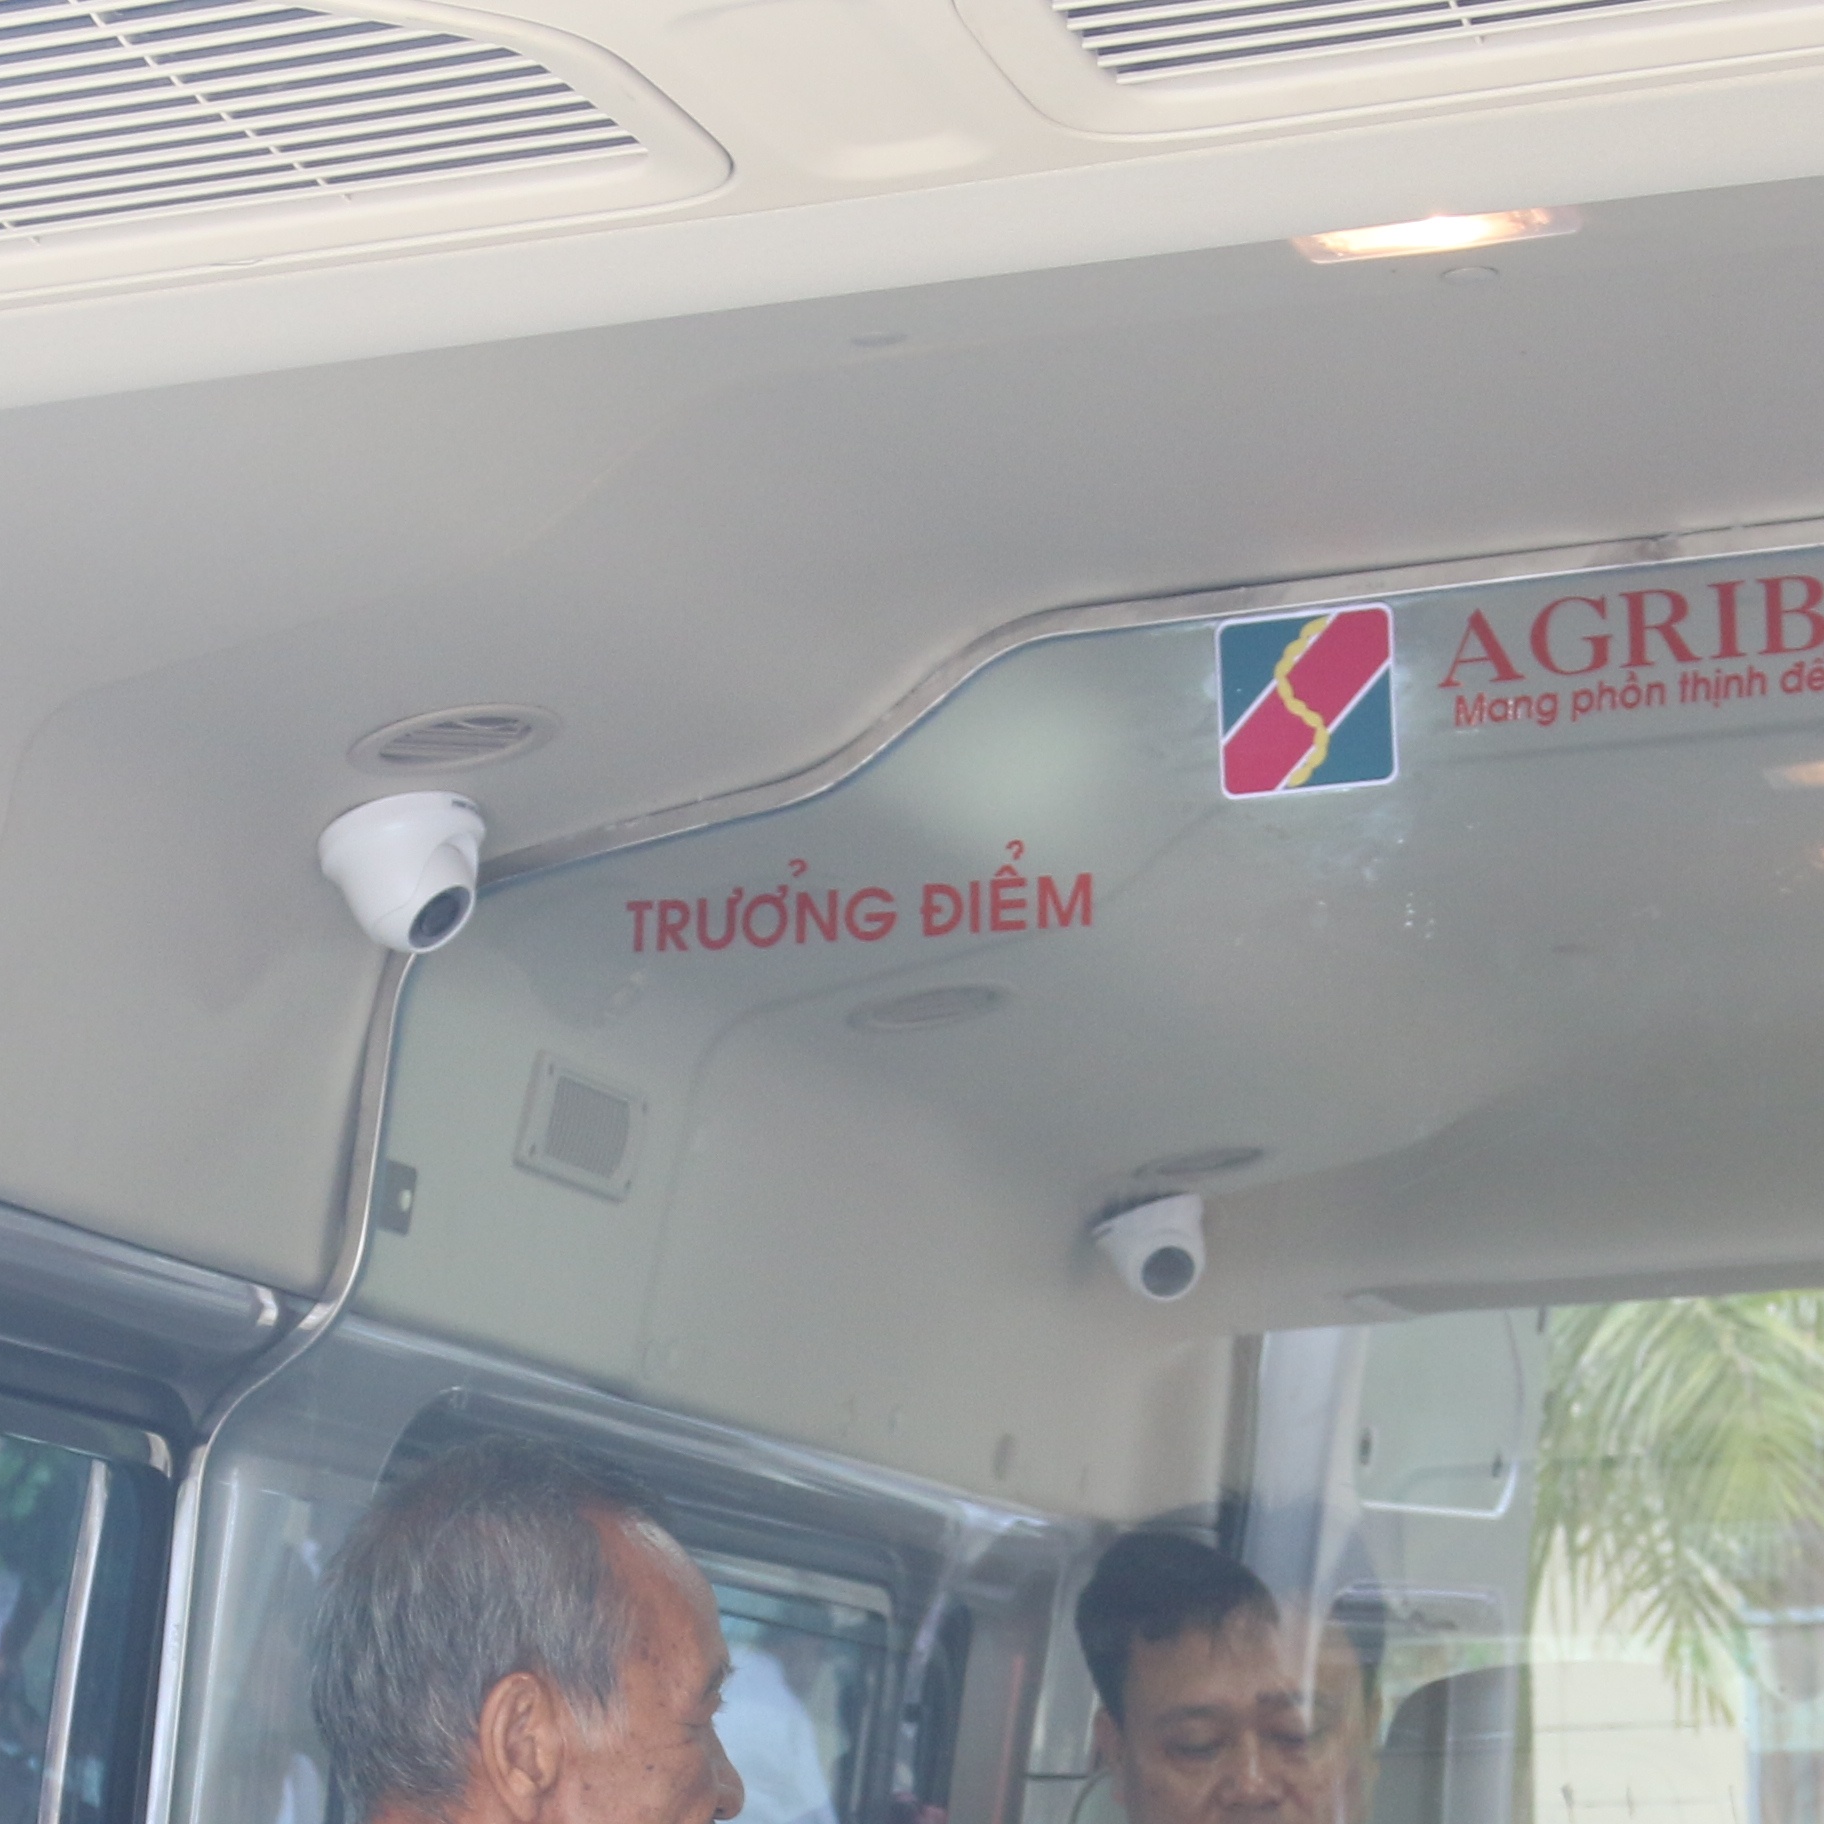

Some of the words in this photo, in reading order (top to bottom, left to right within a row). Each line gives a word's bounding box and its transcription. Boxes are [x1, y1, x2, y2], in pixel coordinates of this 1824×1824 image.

[1455, 691, 1559, 727] Mang
[1680, 667, 1768, 709] thịnh
[626, 858, 897, 953] TRƯỞNG
[920, 839, 1094, 937] ĐIỂM
